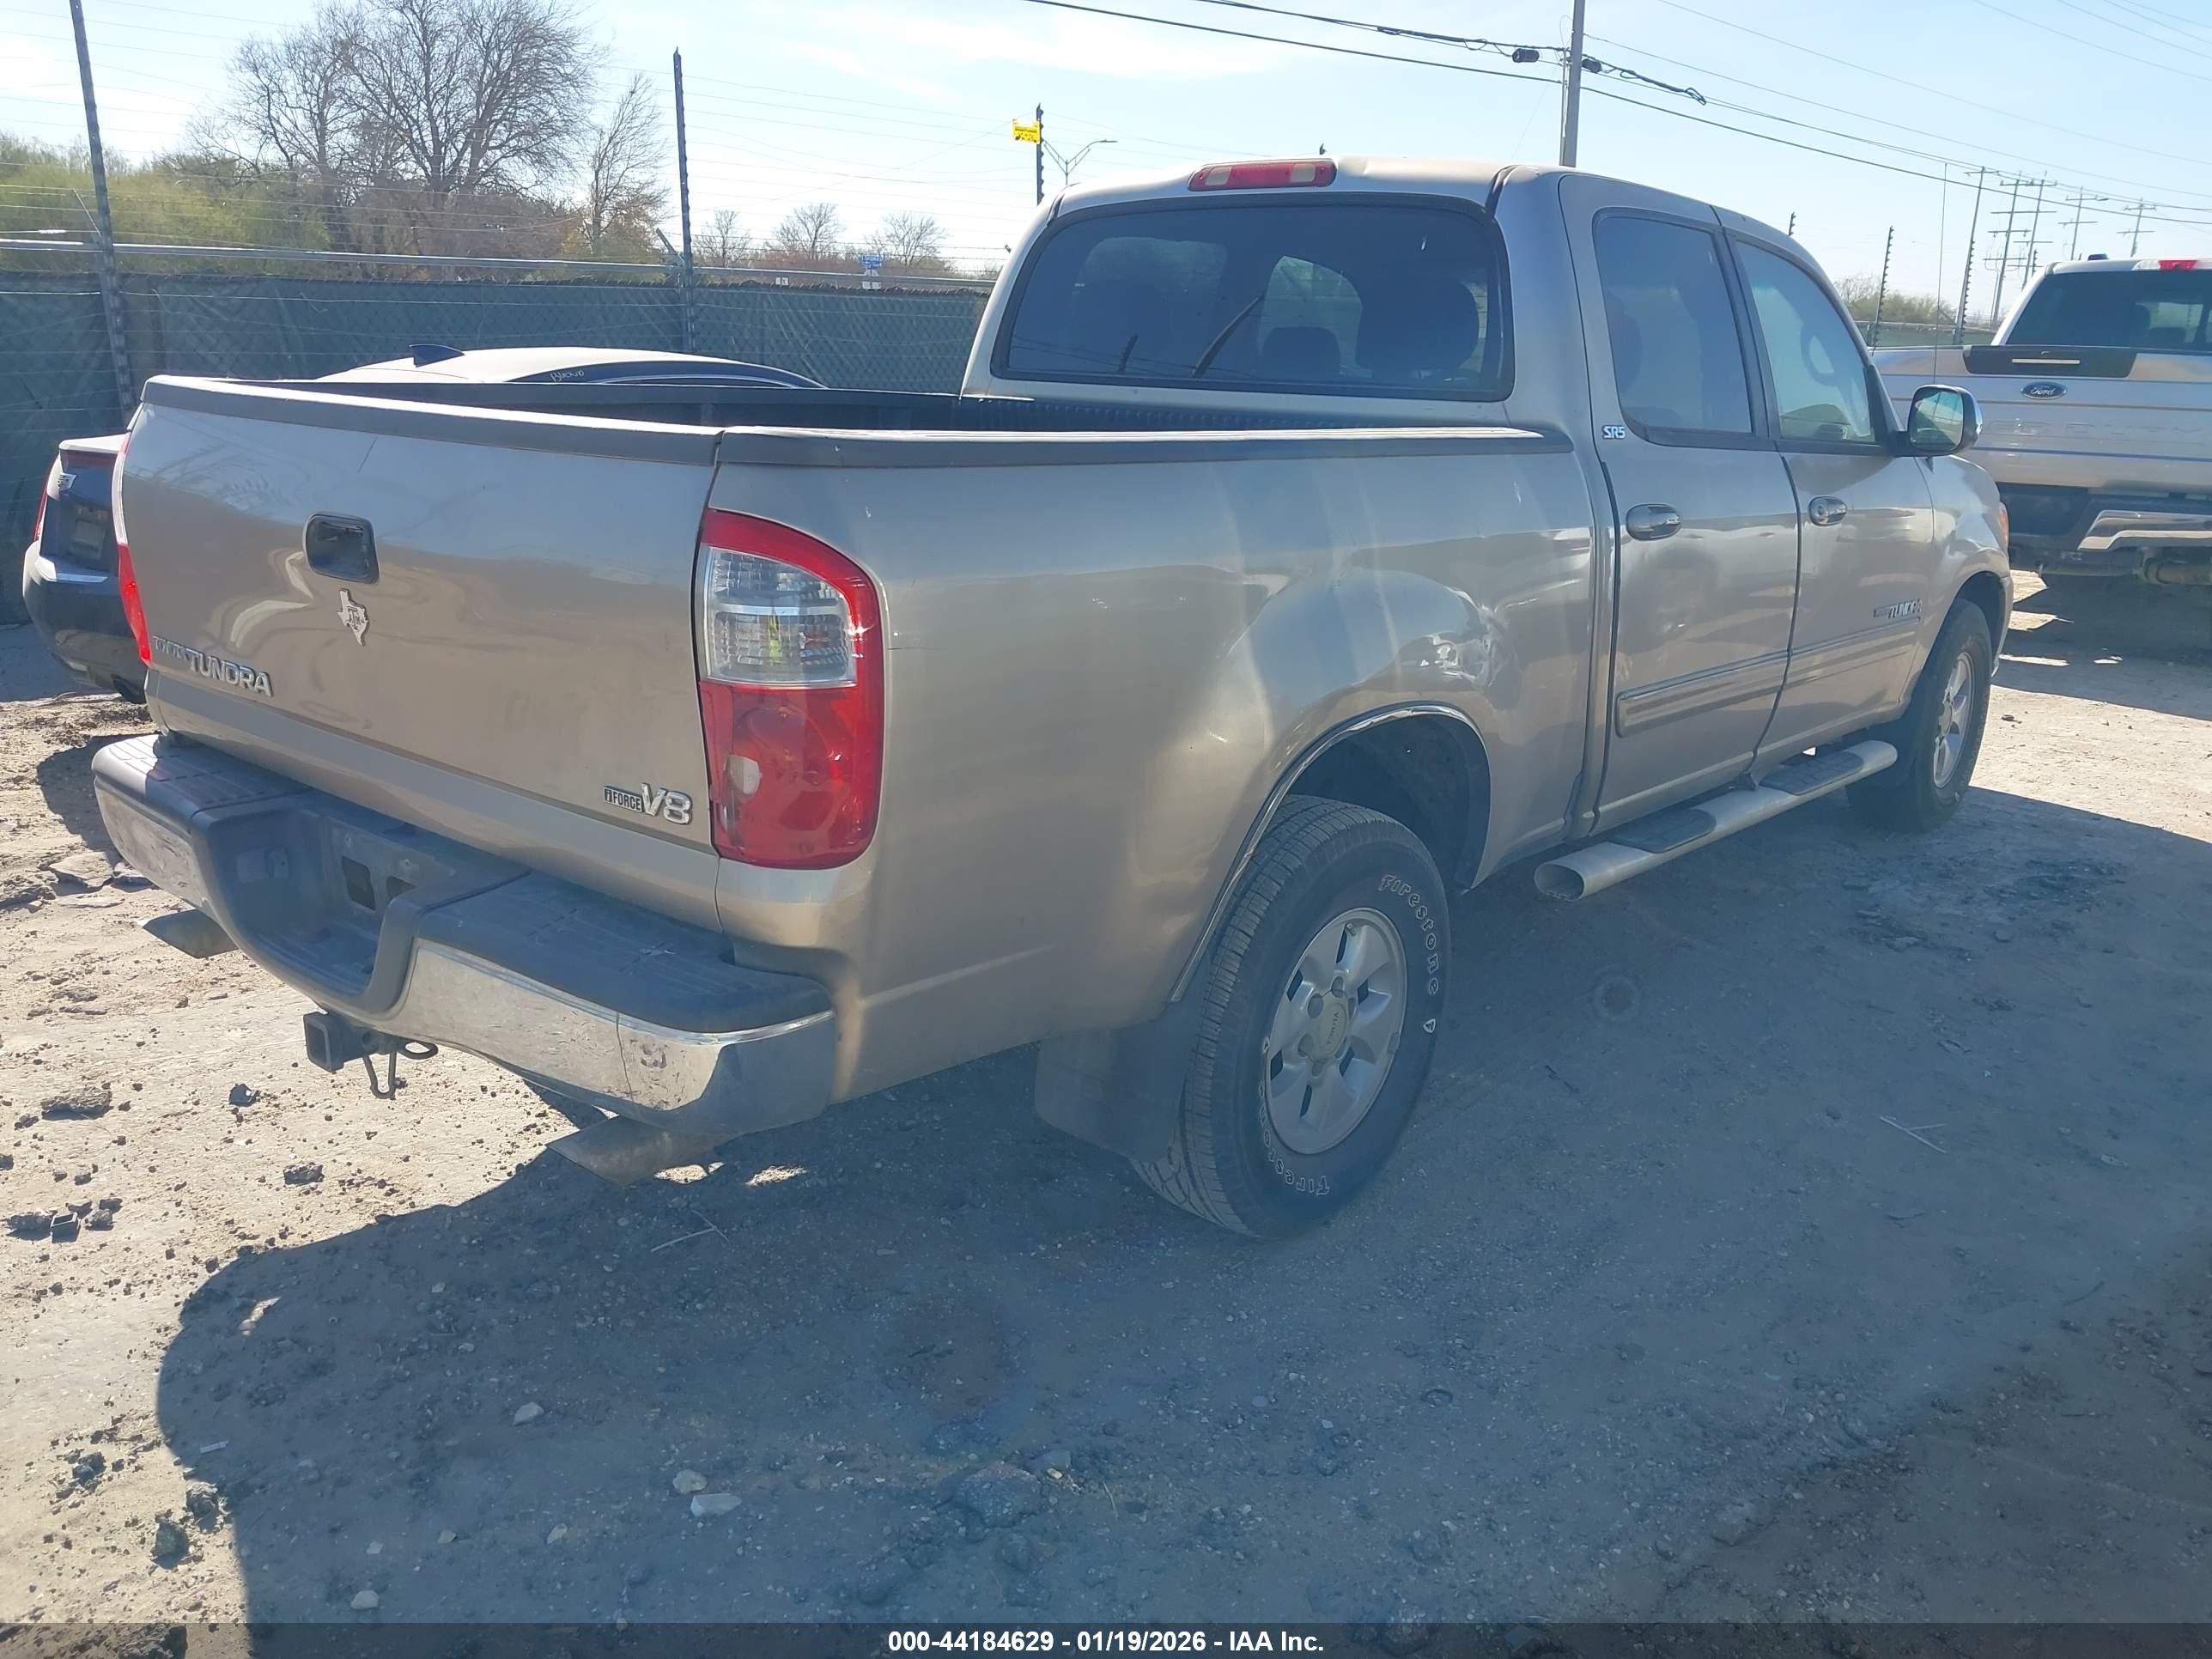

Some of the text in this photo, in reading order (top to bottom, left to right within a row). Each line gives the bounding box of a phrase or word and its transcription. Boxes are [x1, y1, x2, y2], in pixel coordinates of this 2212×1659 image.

[2030, 386, 2056, 396] Ford
[1602, 425, 1626, 439] SR5
[185, 647, 274, 697] TUNDRA
[641, 782, 693, 824] V8
[1378, 874, 1439, 994] Firestone
